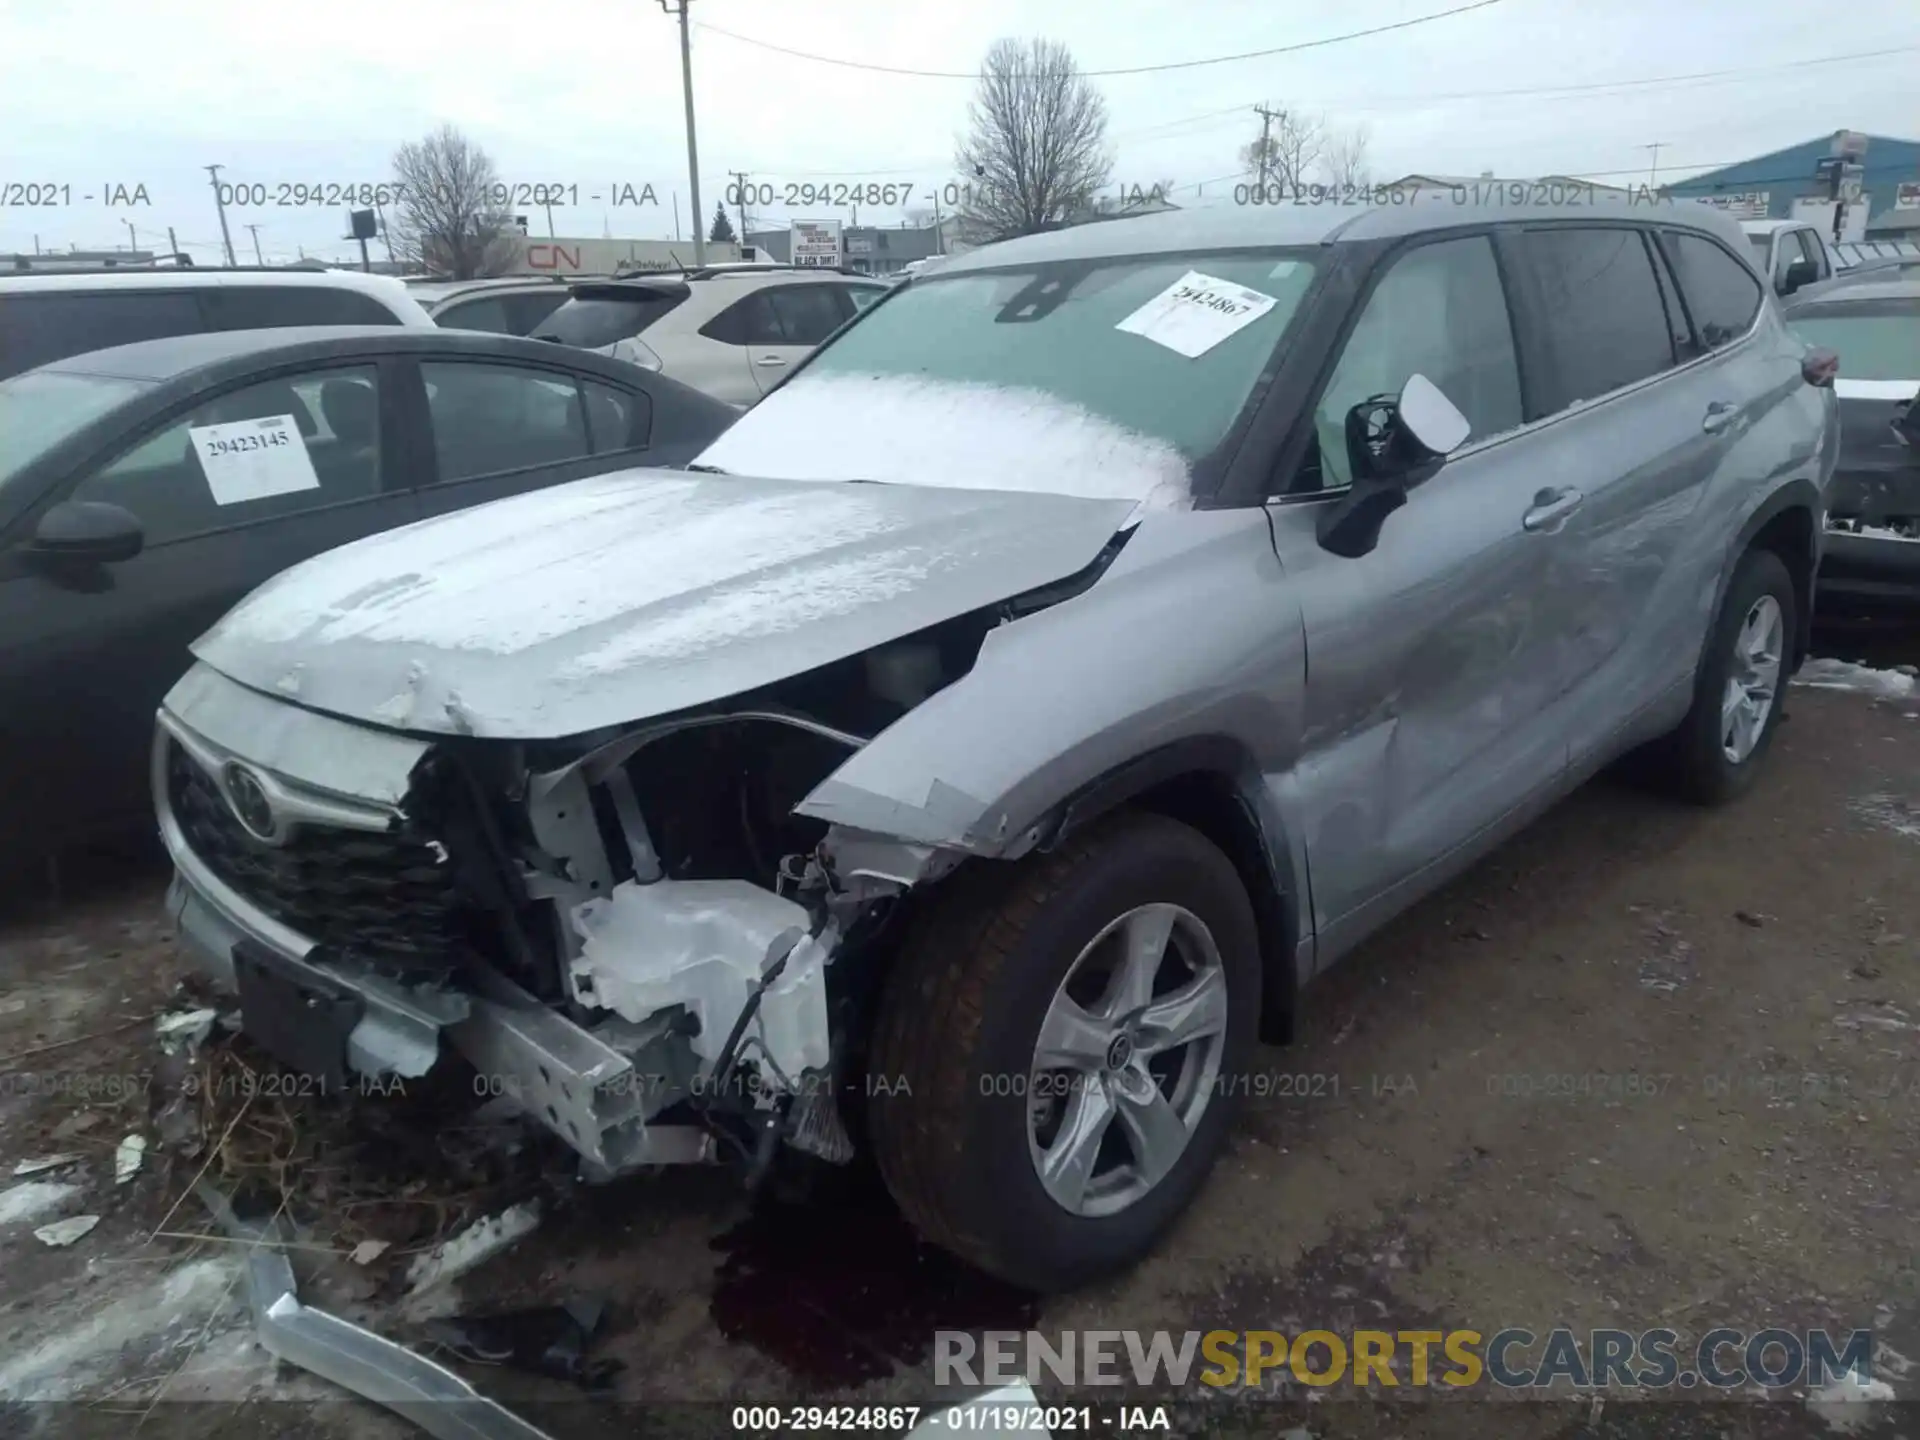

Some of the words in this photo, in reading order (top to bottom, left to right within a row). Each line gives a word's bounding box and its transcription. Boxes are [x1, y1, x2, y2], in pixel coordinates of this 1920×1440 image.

[528, 244, 580, 269] CN
[1172, 285, 1252, 316] 29424867
[207, 431, 289, 457] 29423145
